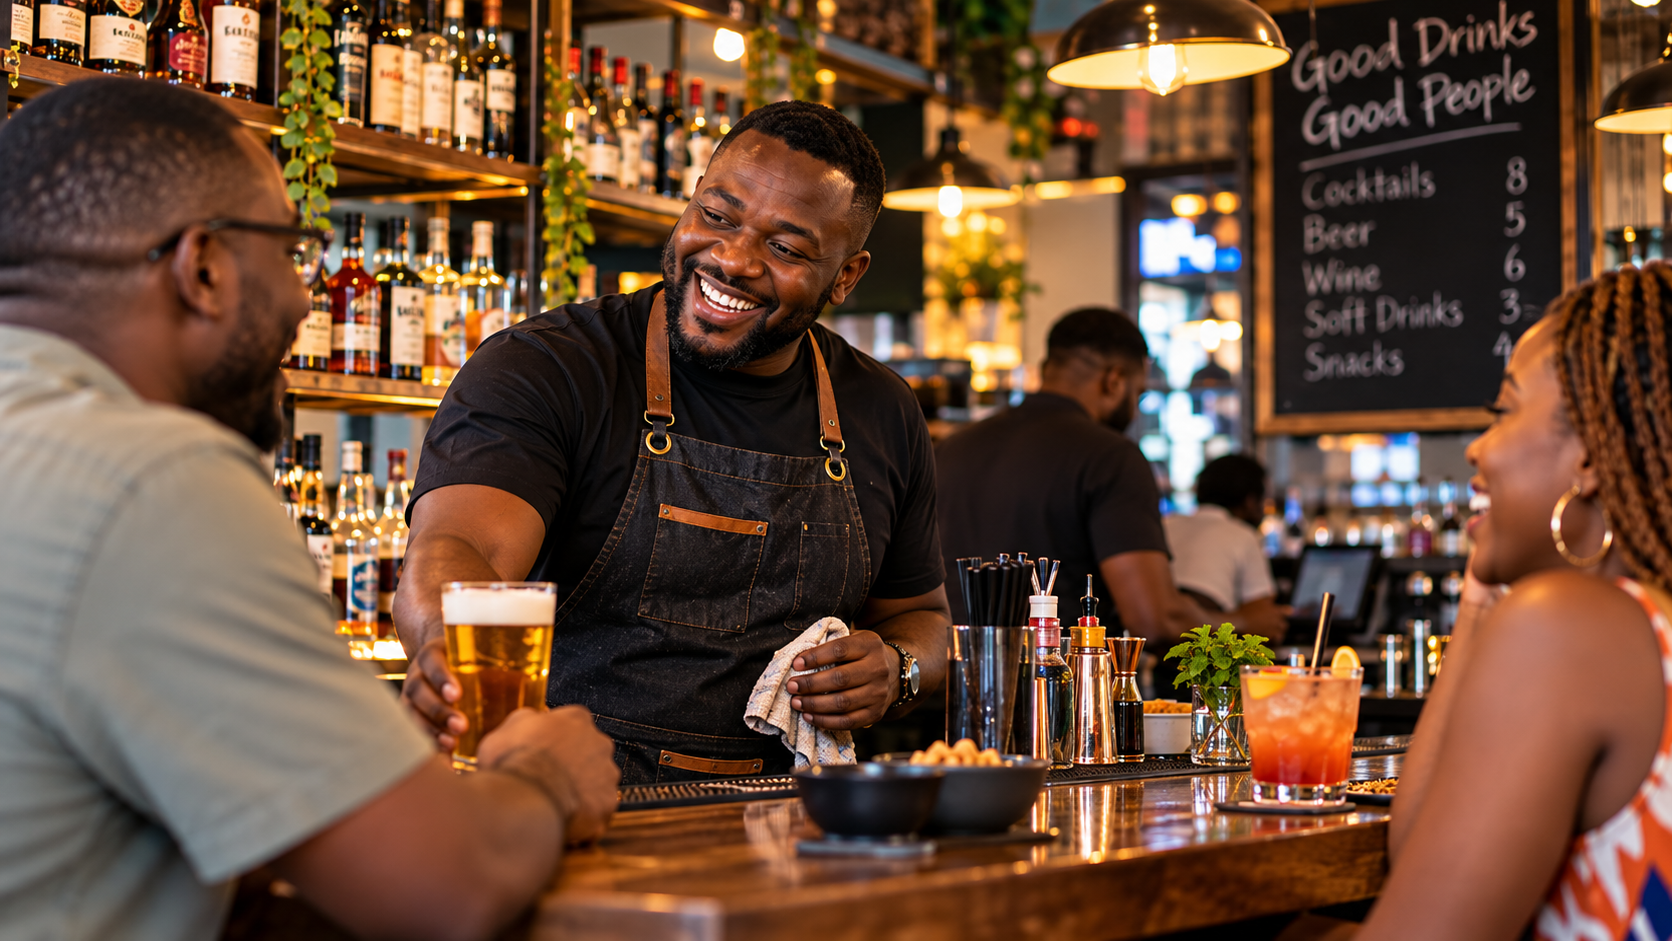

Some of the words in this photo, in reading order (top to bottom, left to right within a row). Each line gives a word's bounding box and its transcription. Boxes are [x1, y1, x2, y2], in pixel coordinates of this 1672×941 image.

[1292, 17, 1404, 93] Good
[1413, 2, 1538, 67] Drinks
[1303, 77, 1410, 149] Good
[1418, 54, 1537, 128] People
[1302, 161, 1436, 209] Cocktails
[1505, 156, 1528, 196] 8
[1303, 213, 1376, 254] Beer
[1504, 201, 1526, 238] 5
[1303, 258, 1382, 296] Wine
[1504, 243, 1526, 282] 6
[1304, 297, 1370, 339] Soft
[1376, 291, 1465, 334] Drinks
[1499, 288, 1521, 325] 3
[1304, 340, 1405, 383] Snacks
